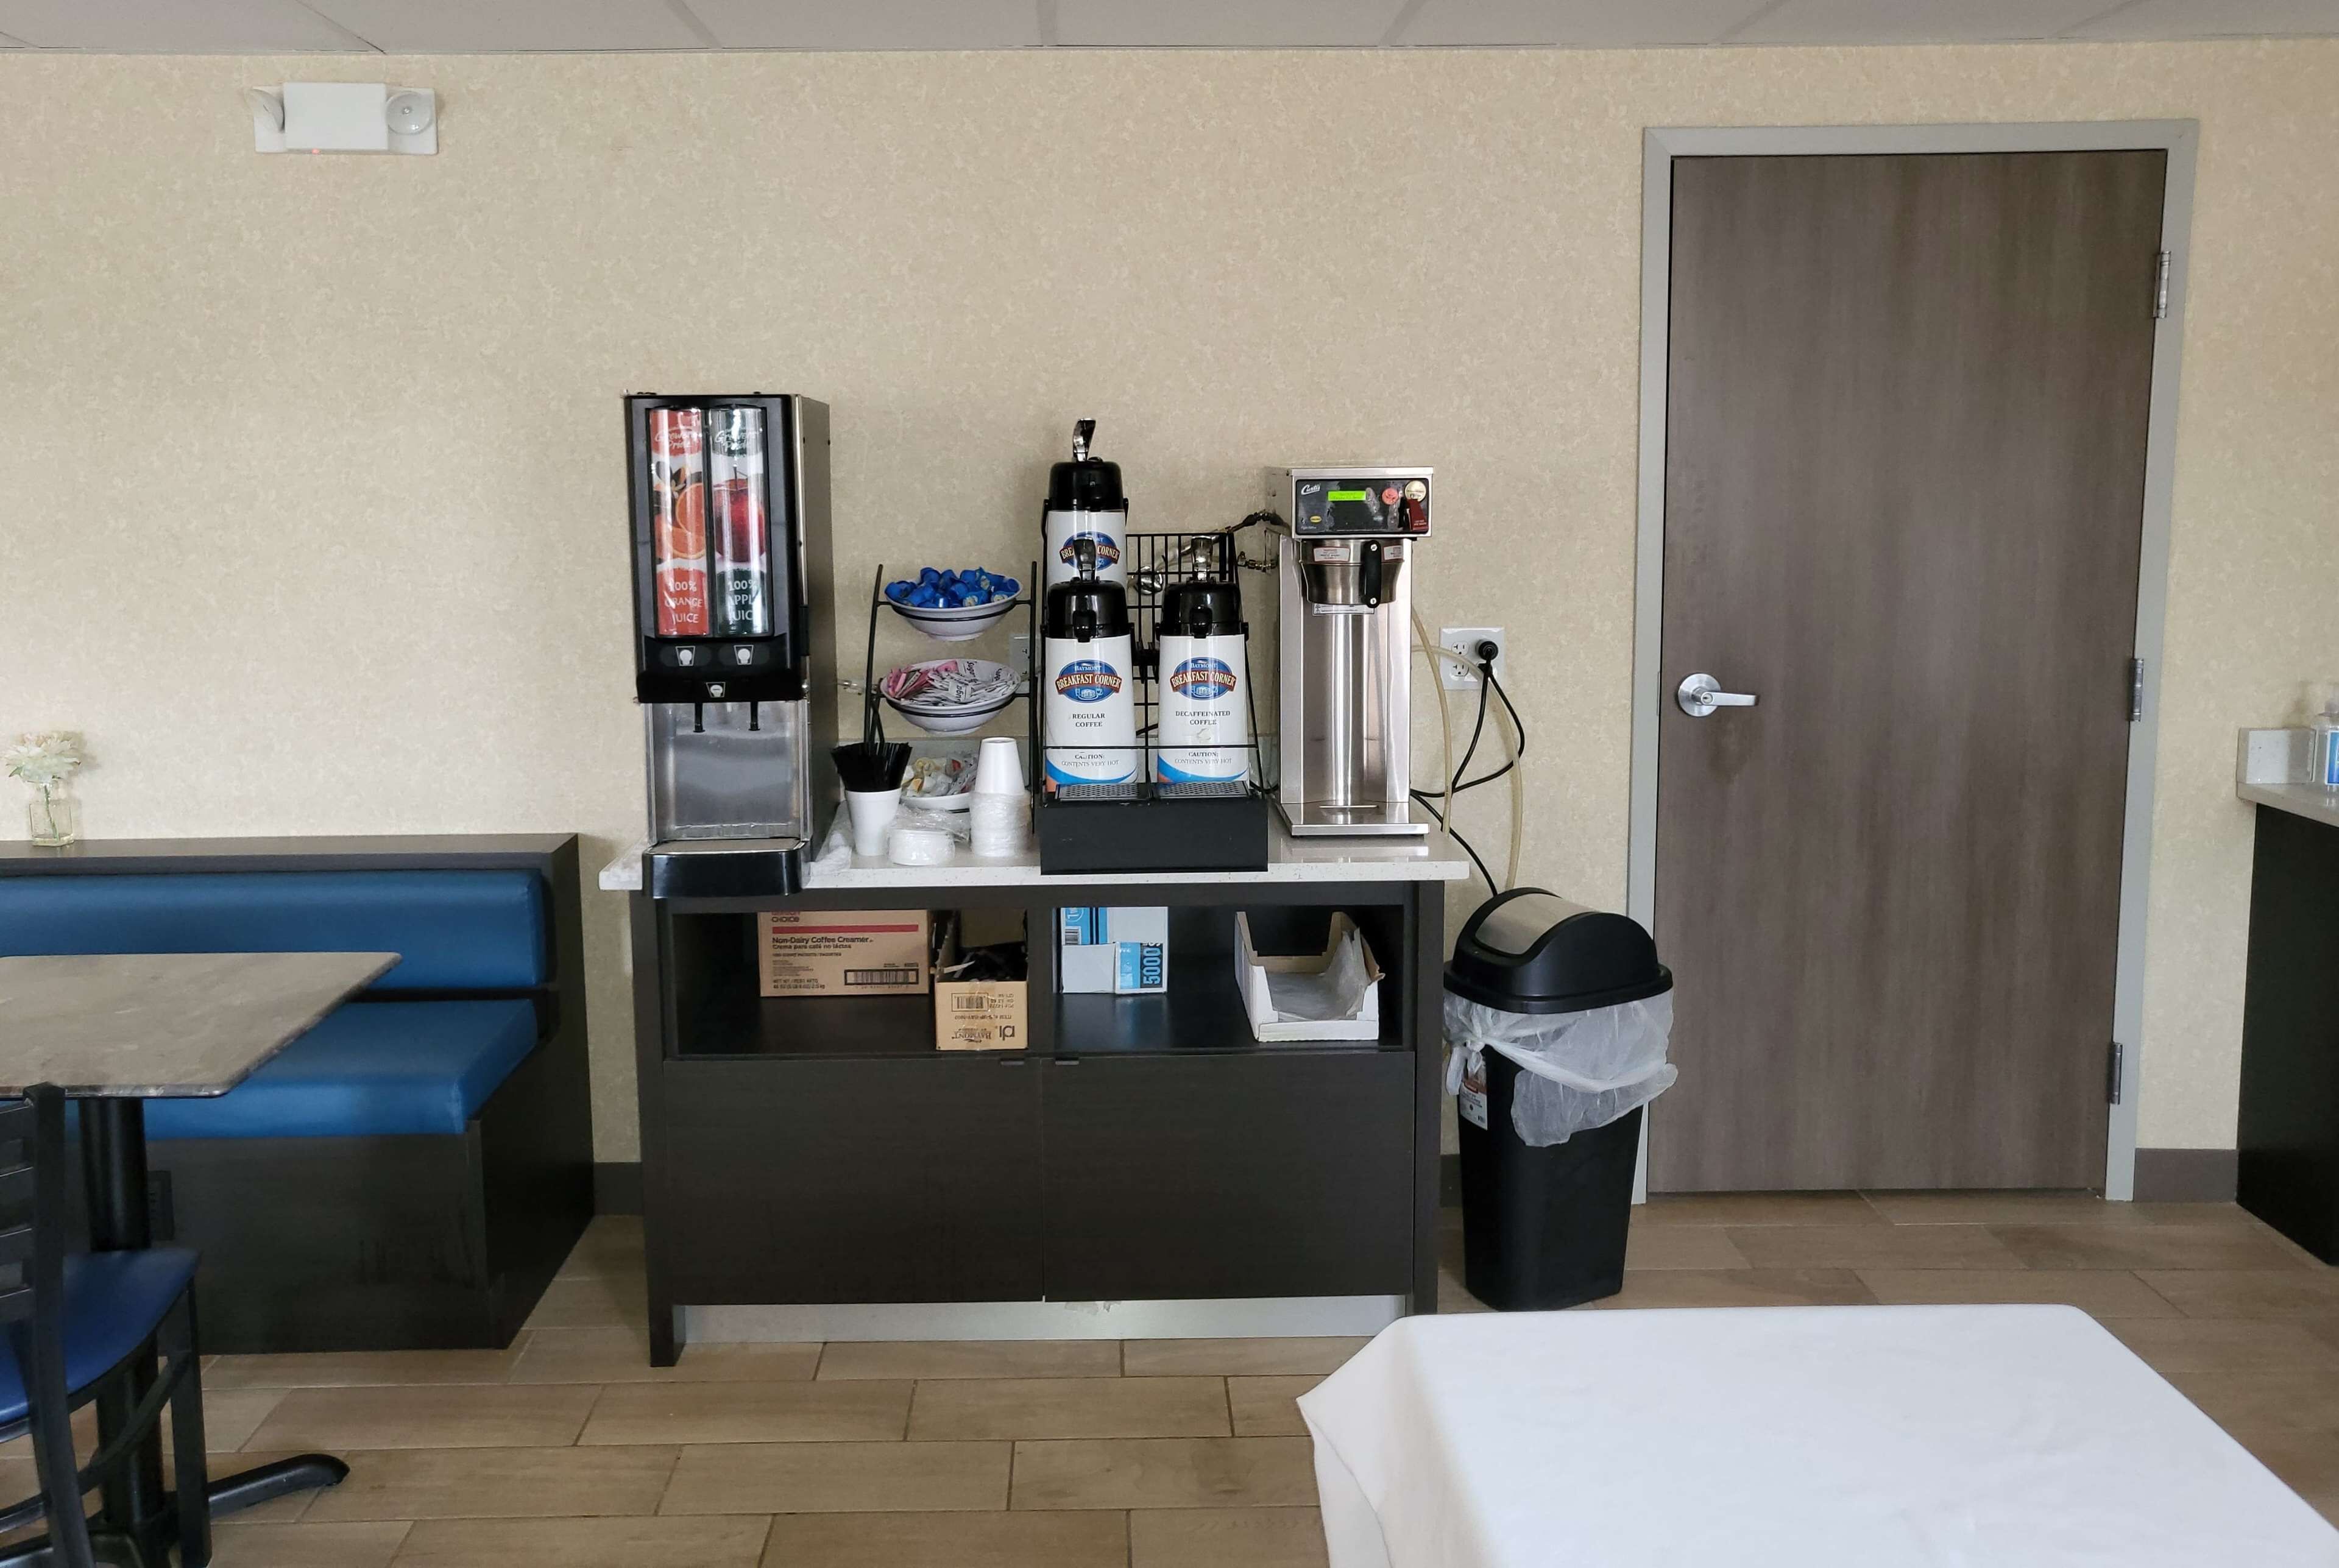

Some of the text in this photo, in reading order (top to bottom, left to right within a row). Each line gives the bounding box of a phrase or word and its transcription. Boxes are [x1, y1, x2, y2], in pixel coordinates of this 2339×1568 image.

[1097, 545, 1119, 559] CORNER
[731, 594, 756, 605] PPL
[731, 610, 755, 621] UIC
[1056, 674, 1120, 690] BREAKFAST CORNER
[1171, 671, 1236, 688] BREAKFAST CORNER
[1143, 947, 1161, 984] 5000
